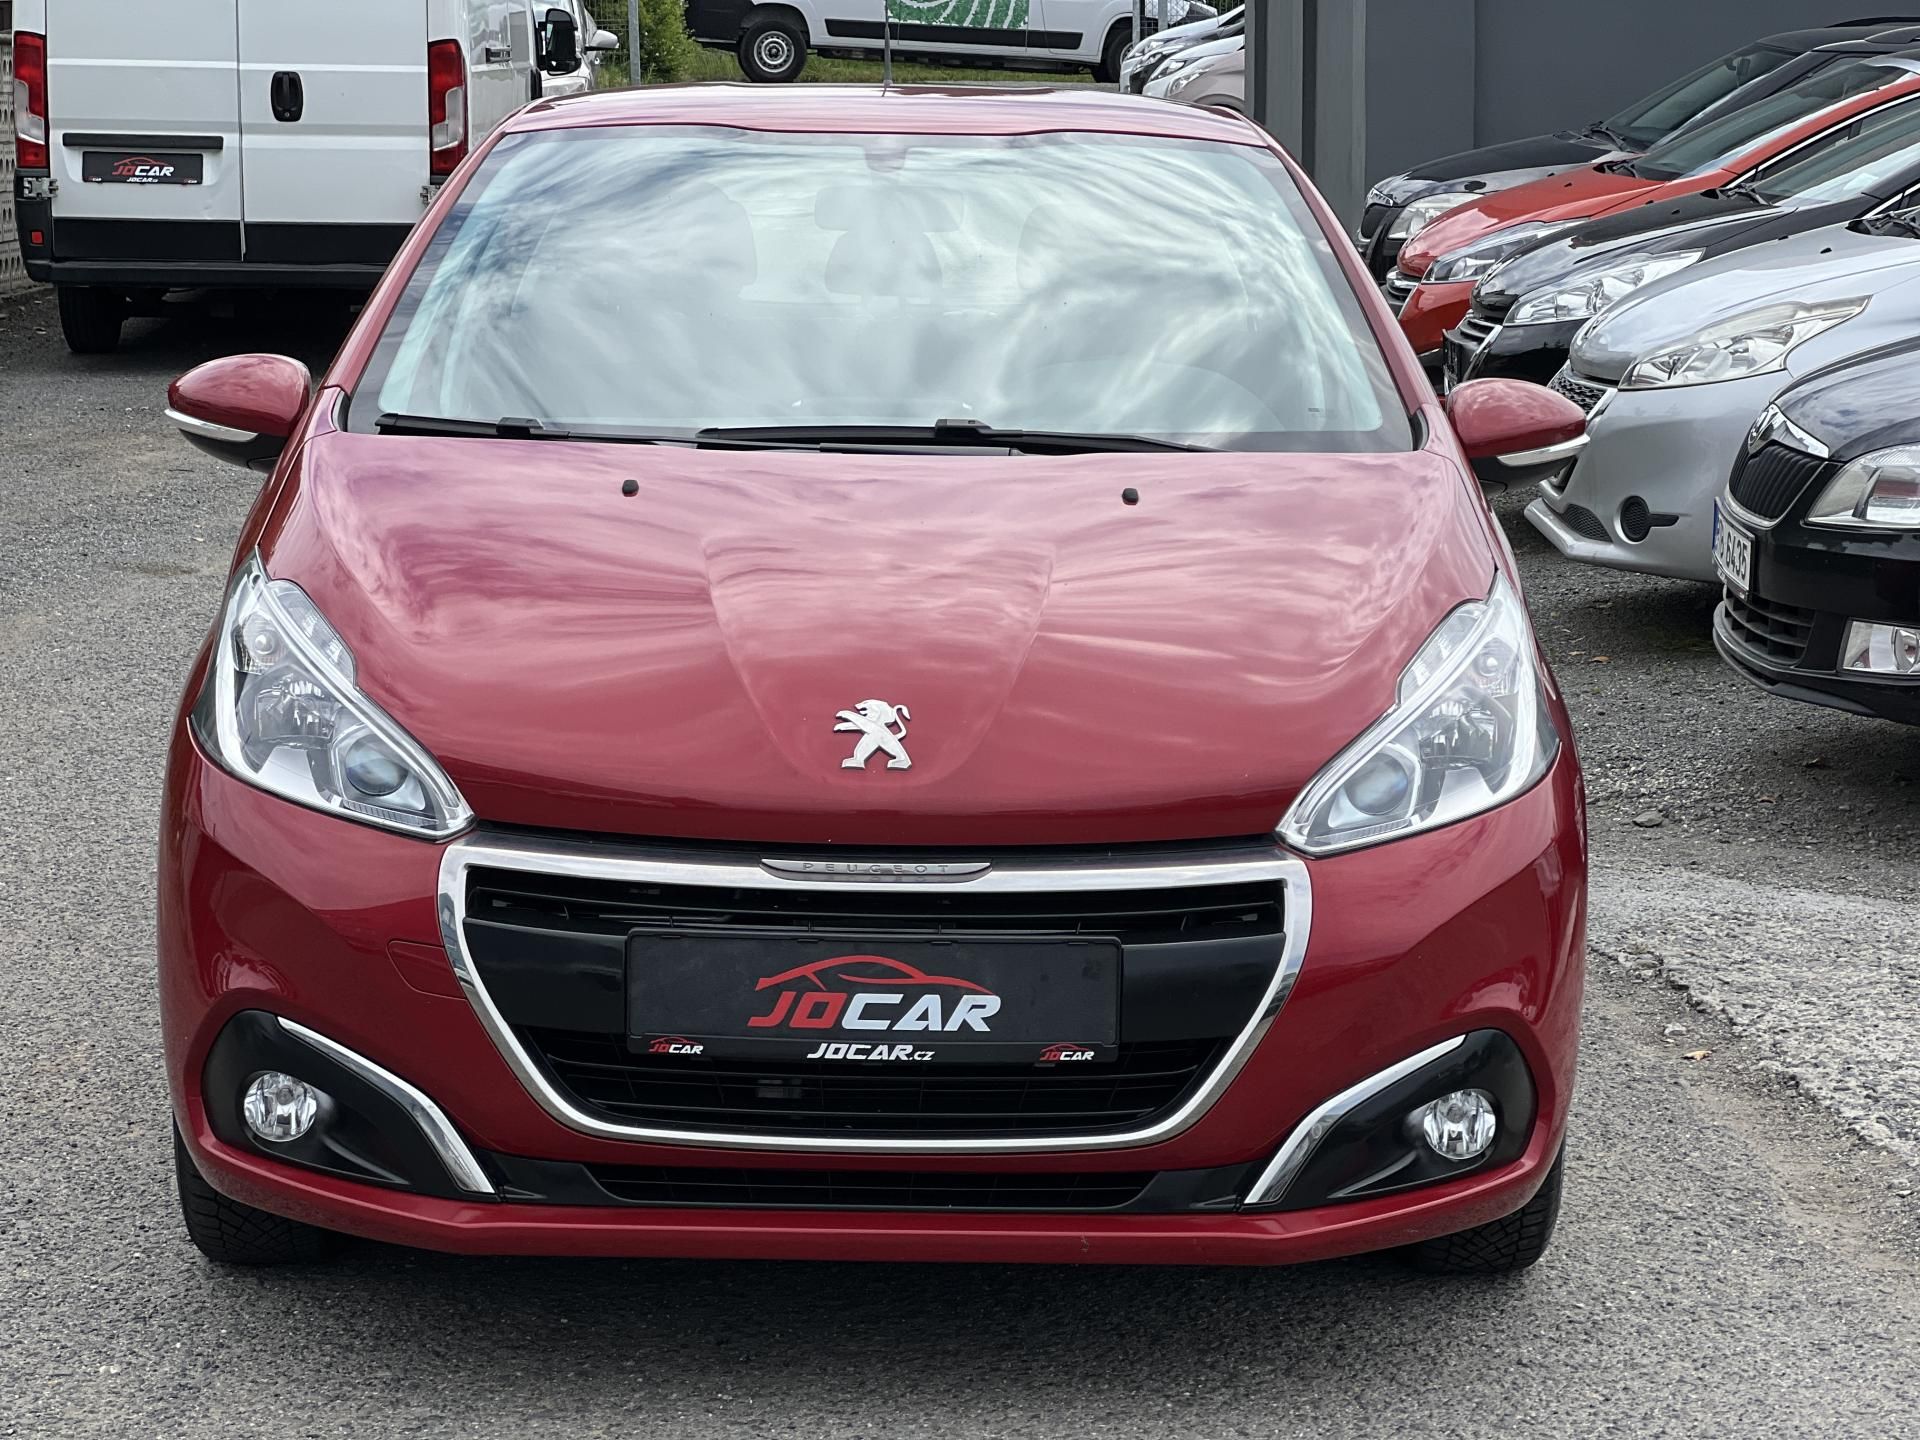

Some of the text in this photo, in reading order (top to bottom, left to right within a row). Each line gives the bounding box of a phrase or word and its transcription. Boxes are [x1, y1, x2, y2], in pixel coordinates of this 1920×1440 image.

[112, 165, 174, 176] JOCAR
[802, 862, 949, 875] PEUGEOT
[747, 992, 1000, 1032] JOCAR
[649, 1043, 704, 1055] JOCAR
[1039, 1051, 1095, 1061] JOCAR
